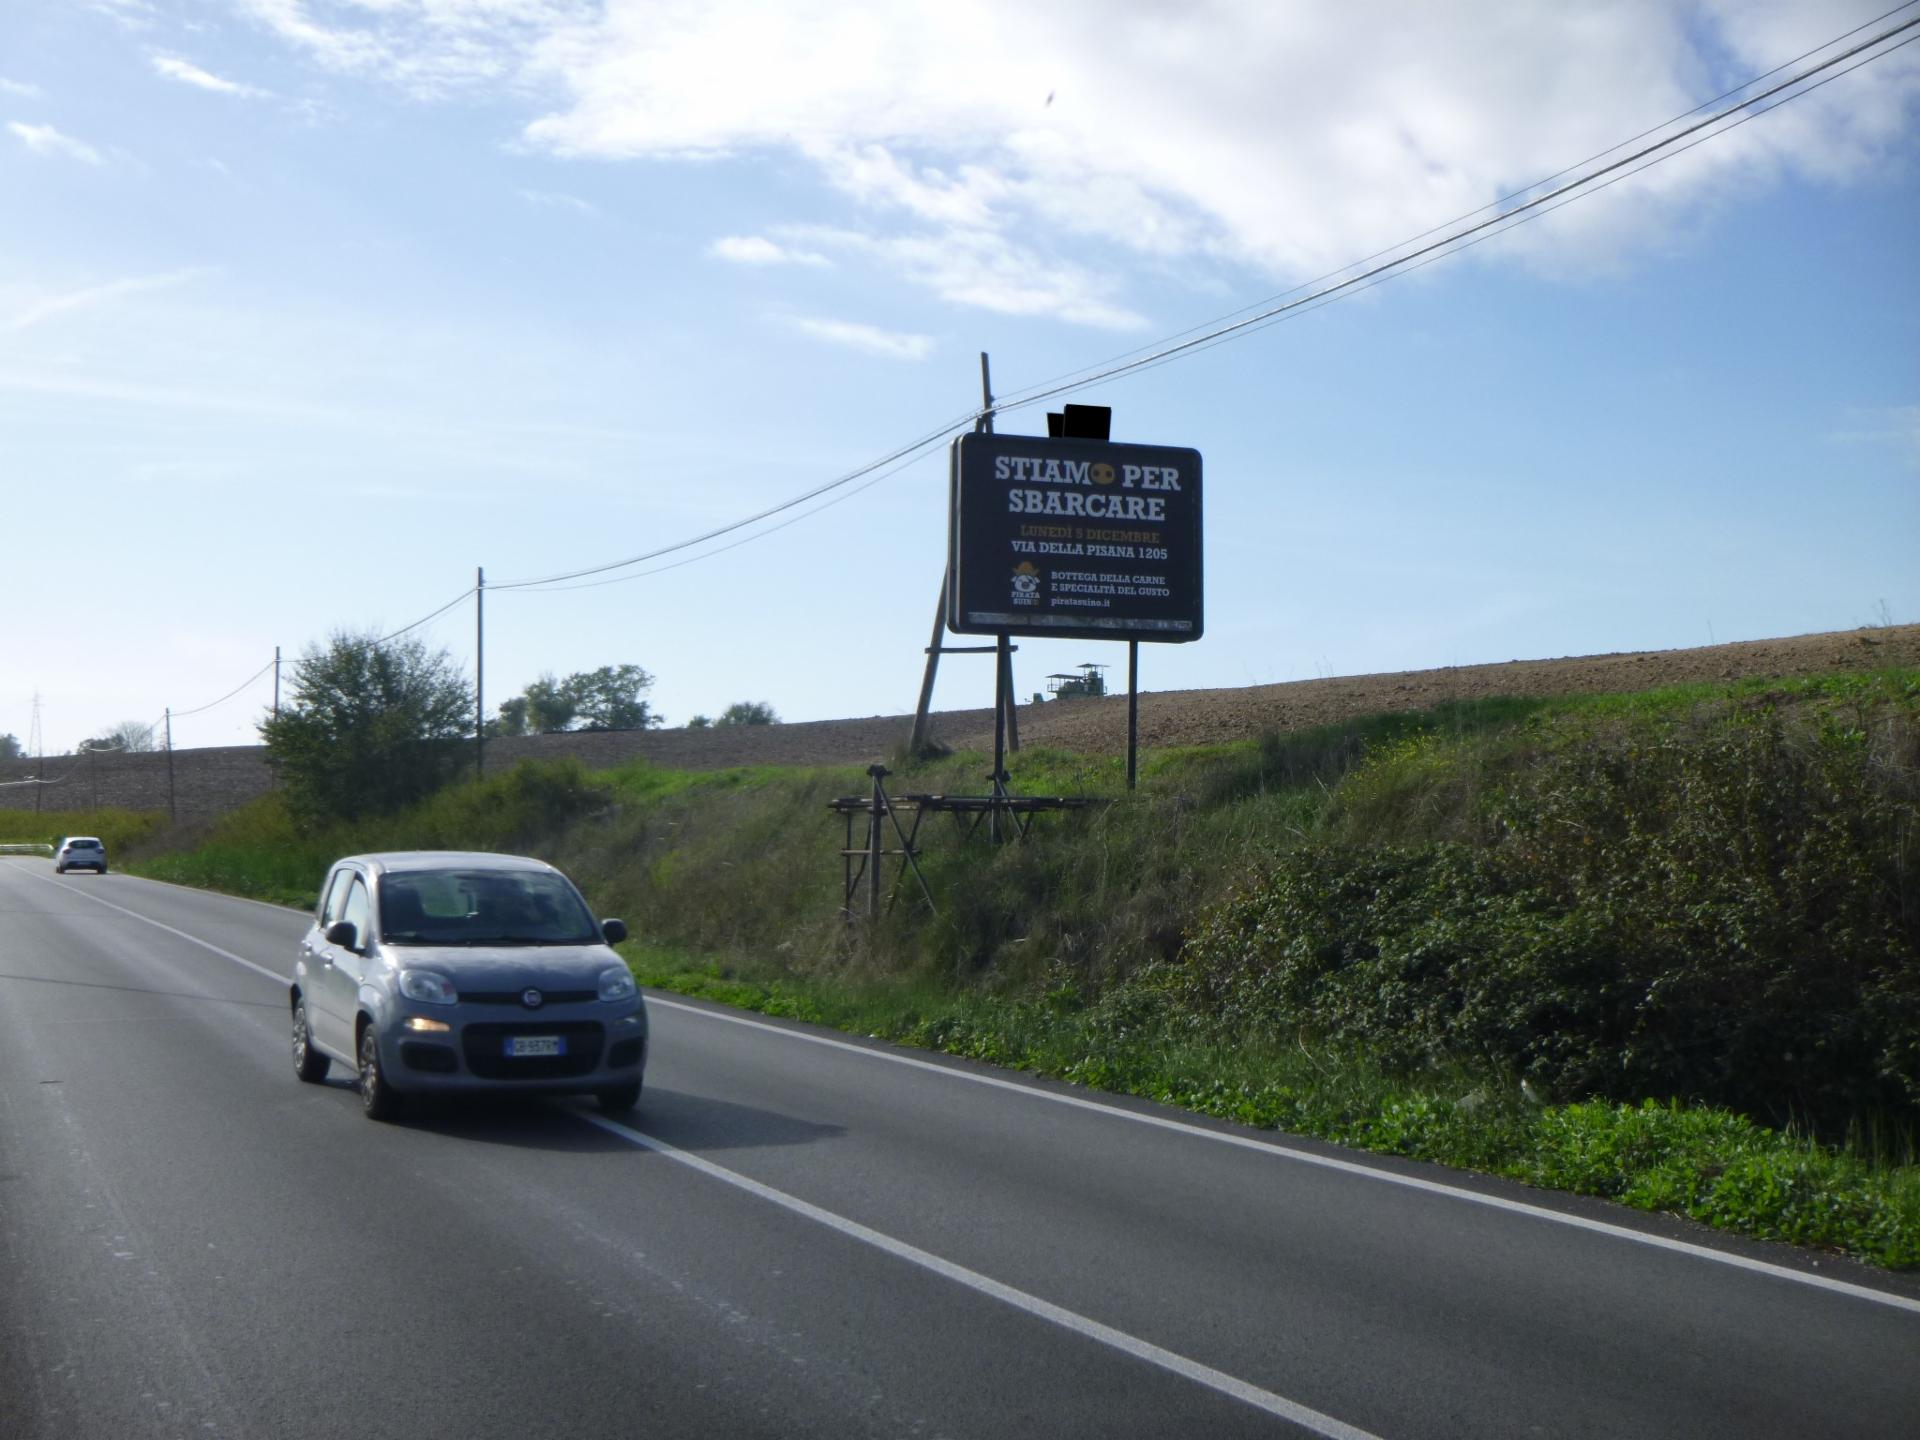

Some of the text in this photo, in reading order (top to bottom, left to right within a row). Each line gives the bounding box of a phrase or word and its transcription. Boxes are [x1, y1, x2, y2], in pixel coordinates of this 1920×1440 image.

[1122, 465, 1181, 491] PER
[1009, 490, 1165, 521] SBARCARE
[1076, 529, 1083, 539] 5
[1086, 529, 1160, 543] DICEMBRE
[1012, 541, 1168, 560] VIA DELLA PISANA 1205
[1051, 572, 1165, 585] BOTTEGA DELLA CARNE
[1051, 583, 1169, 597] E SPECIALITÀ DEL GUSTO
[1051, 597, 1110, 607] piratasuino.it
